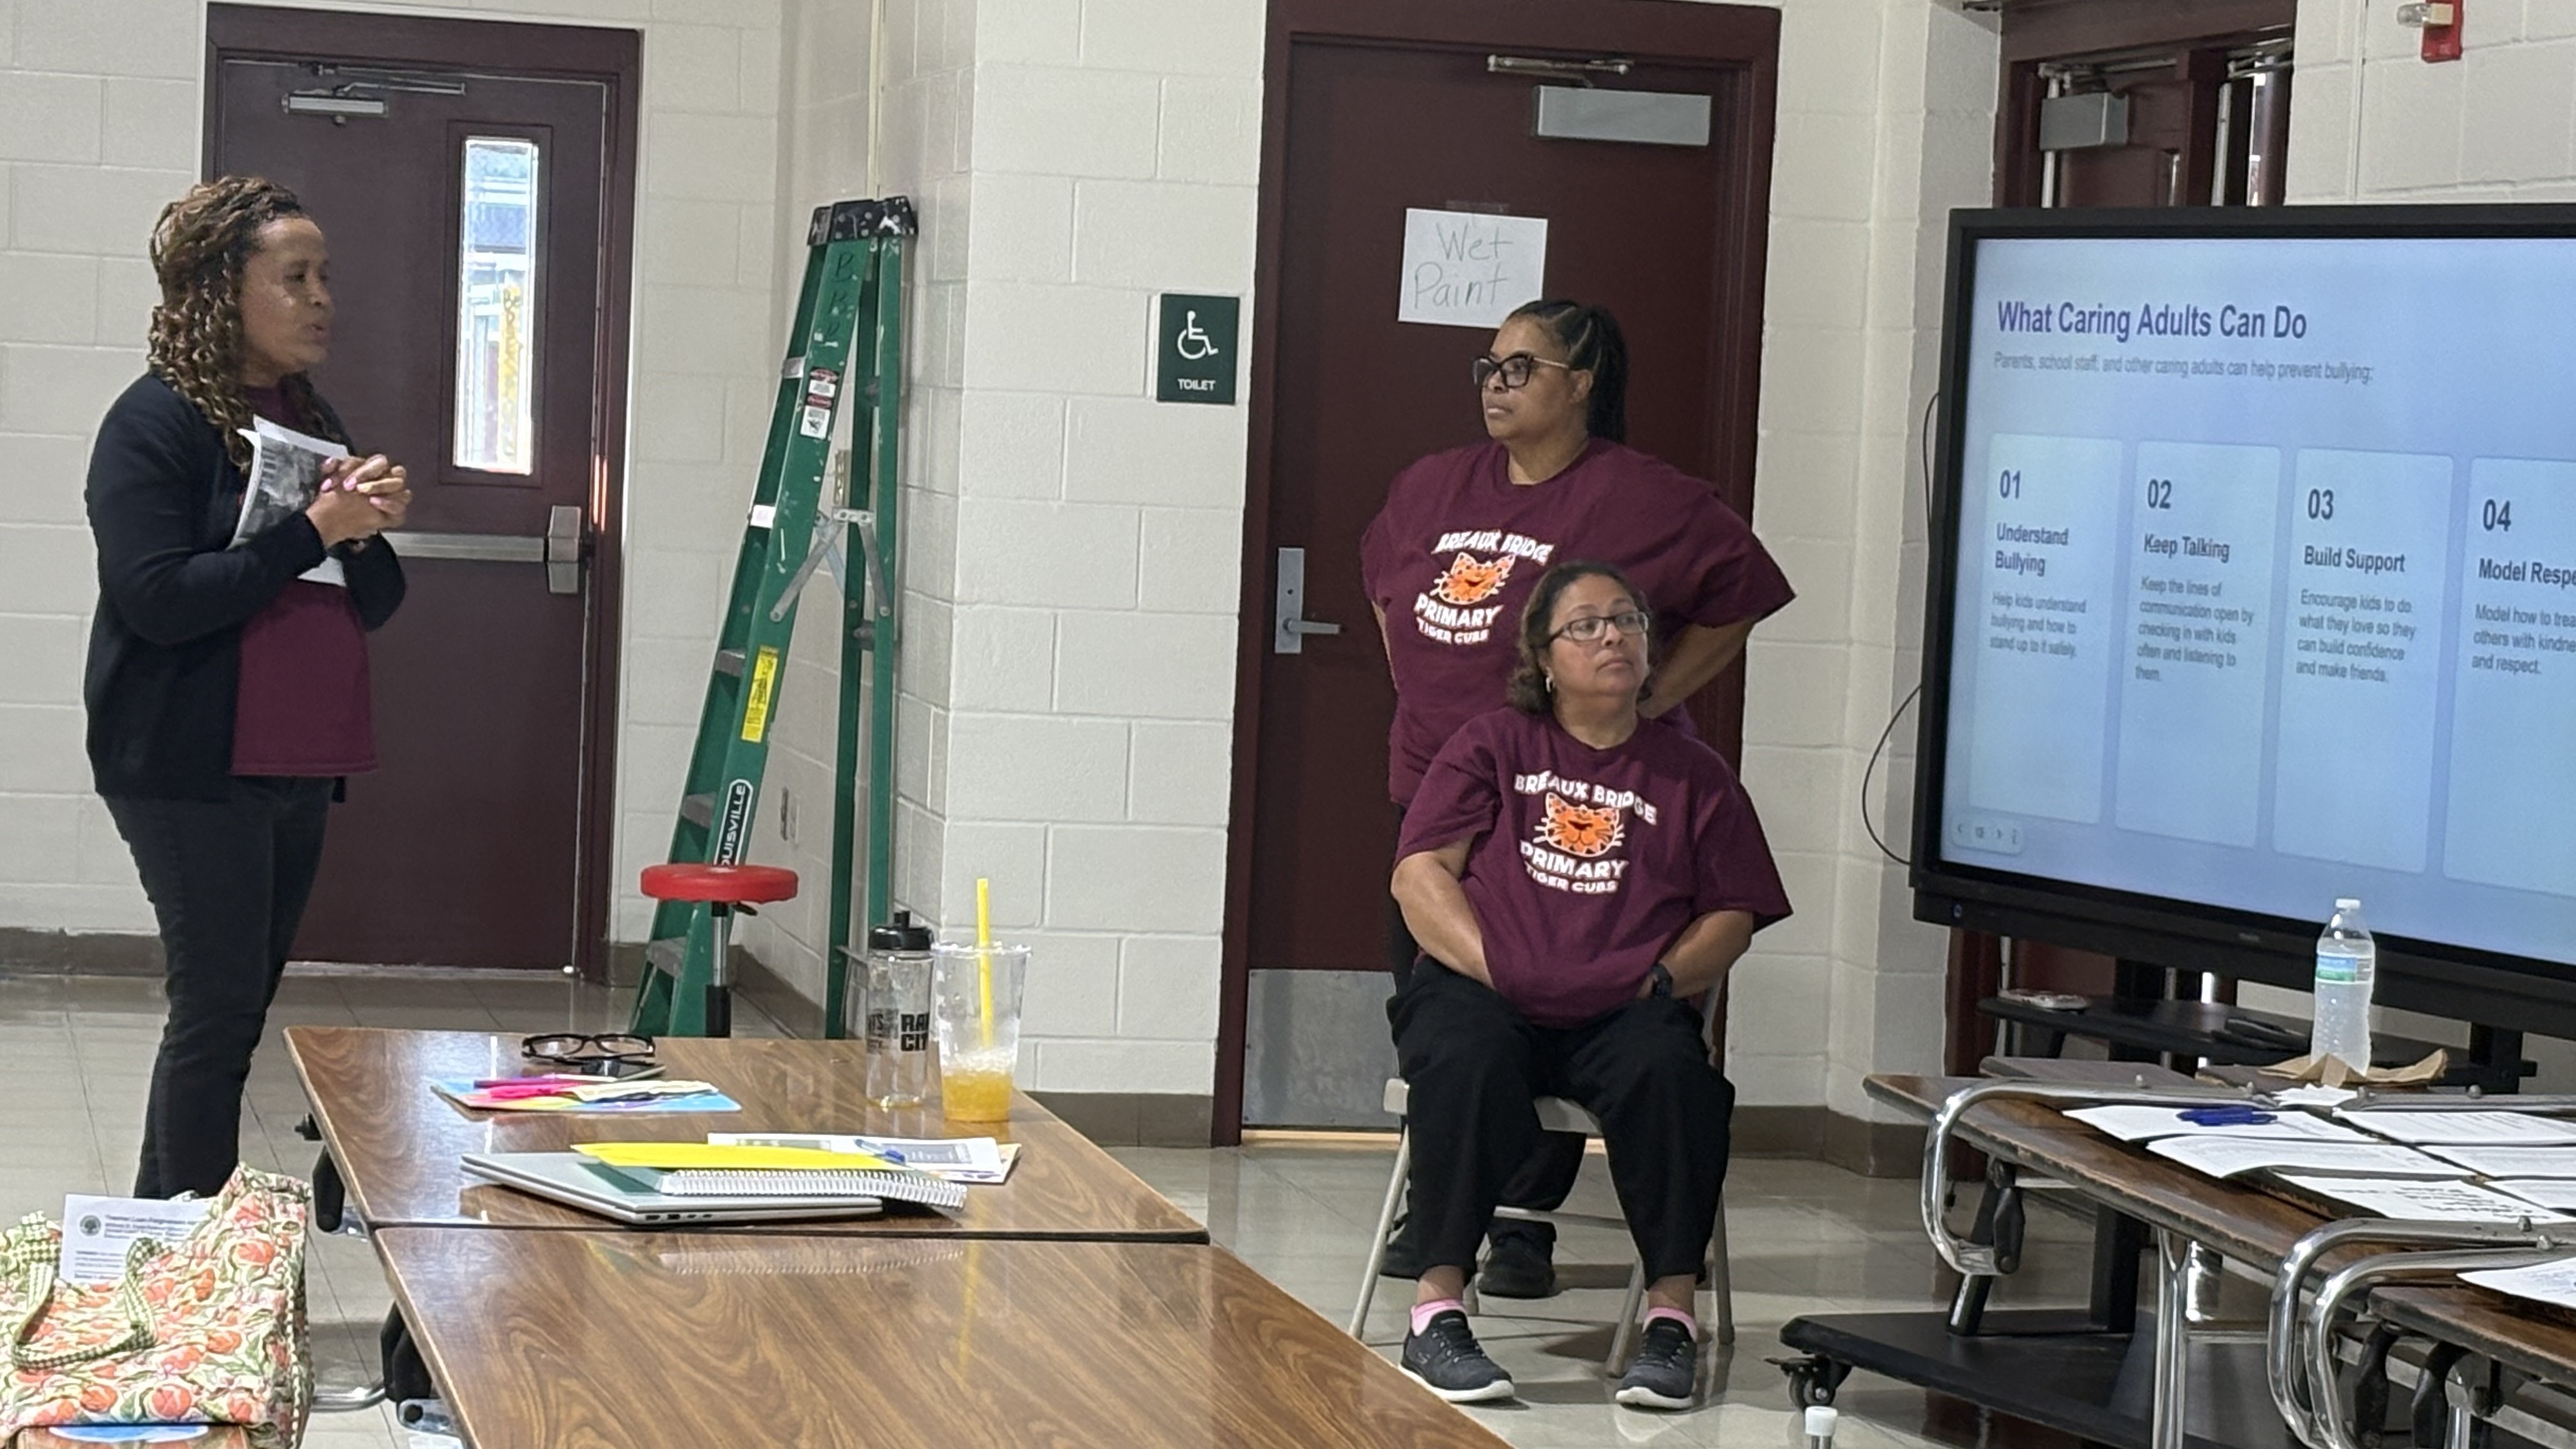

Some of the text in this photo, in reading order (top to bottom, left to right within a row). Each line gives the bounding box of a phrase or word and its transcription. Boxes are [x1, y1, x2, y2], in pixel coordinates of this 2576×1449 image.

[1436, 222, 1514, 262] Wet
[1414, 261, 1510, 309] Paint
[1997, 300, 2306, 343] What Caring Adults Can Do
[2038, 355, 2073, 371] school
[2102, 356, 2122, 373] and
[2124, 356, 2152, 374] other
[2191, 359, 2225, 376] adults
[2227, 362, 2248, 377] can
[2251, 360, 2275, 381] help
[2278, 362, 2322, 381] prevent
[1177, 378, 1216, 392] TOILET
[2000, 470, 2021, 499] 01
[2147, 479, 2172, 509] 02
[2308, 489, 2334, 519] 03
[2483, 499, 2511, 532] 04
[1997, 522, 2069, 546] Understand
[1431, 530, 1554, 567] BREAUX BRIDGE
[2143, 533, 2230, 564] Keep Talking
[2304, 545, 2405, 576] Build Support
[1995, 550, 2046, 577] Bullying
[2478, 558, 2526, 582] Model
[2140, 576, 2223, 597] Keep the lines of
[1413, 593, 1504, 628] PRIMARY
[2035, 596, 2087, 613] understand
[2139, 599, 2255, 627] communication open by
[2301, 588, 2412, 614] Encourage kids to do
[2475, 603, 2510, 624] Model
[2513, 606, 2536, 626] how
[2540, 609, 2552, 627] to
[1414, 617, 1489, 645] TIGER CUBS
[2046, 620, 2065, 634] how
[2067, 620, 2076, 634] to
[2138, 622, 2237, 645] checking in with kids
[2299, 613, 2417, 641] what they love so they
[2473, 630, 2510, 647] others
[2512, 632, 2535, 649] with
[2136, 642, 2237, 669] often and listening to
[2297, 638, 2405, 661] can build confidence
[2296, 659, 2316, 675] and
[2318, 662, 2347, 679] make
[2472, 654, 2542, 675] and respect.
[1514, 770, 1657, 826] BREAUX BRIDGE
[1520, 839, 1630, 879] PRIMARY
[1524, 861, 1619, 894] TIGER CUBS
